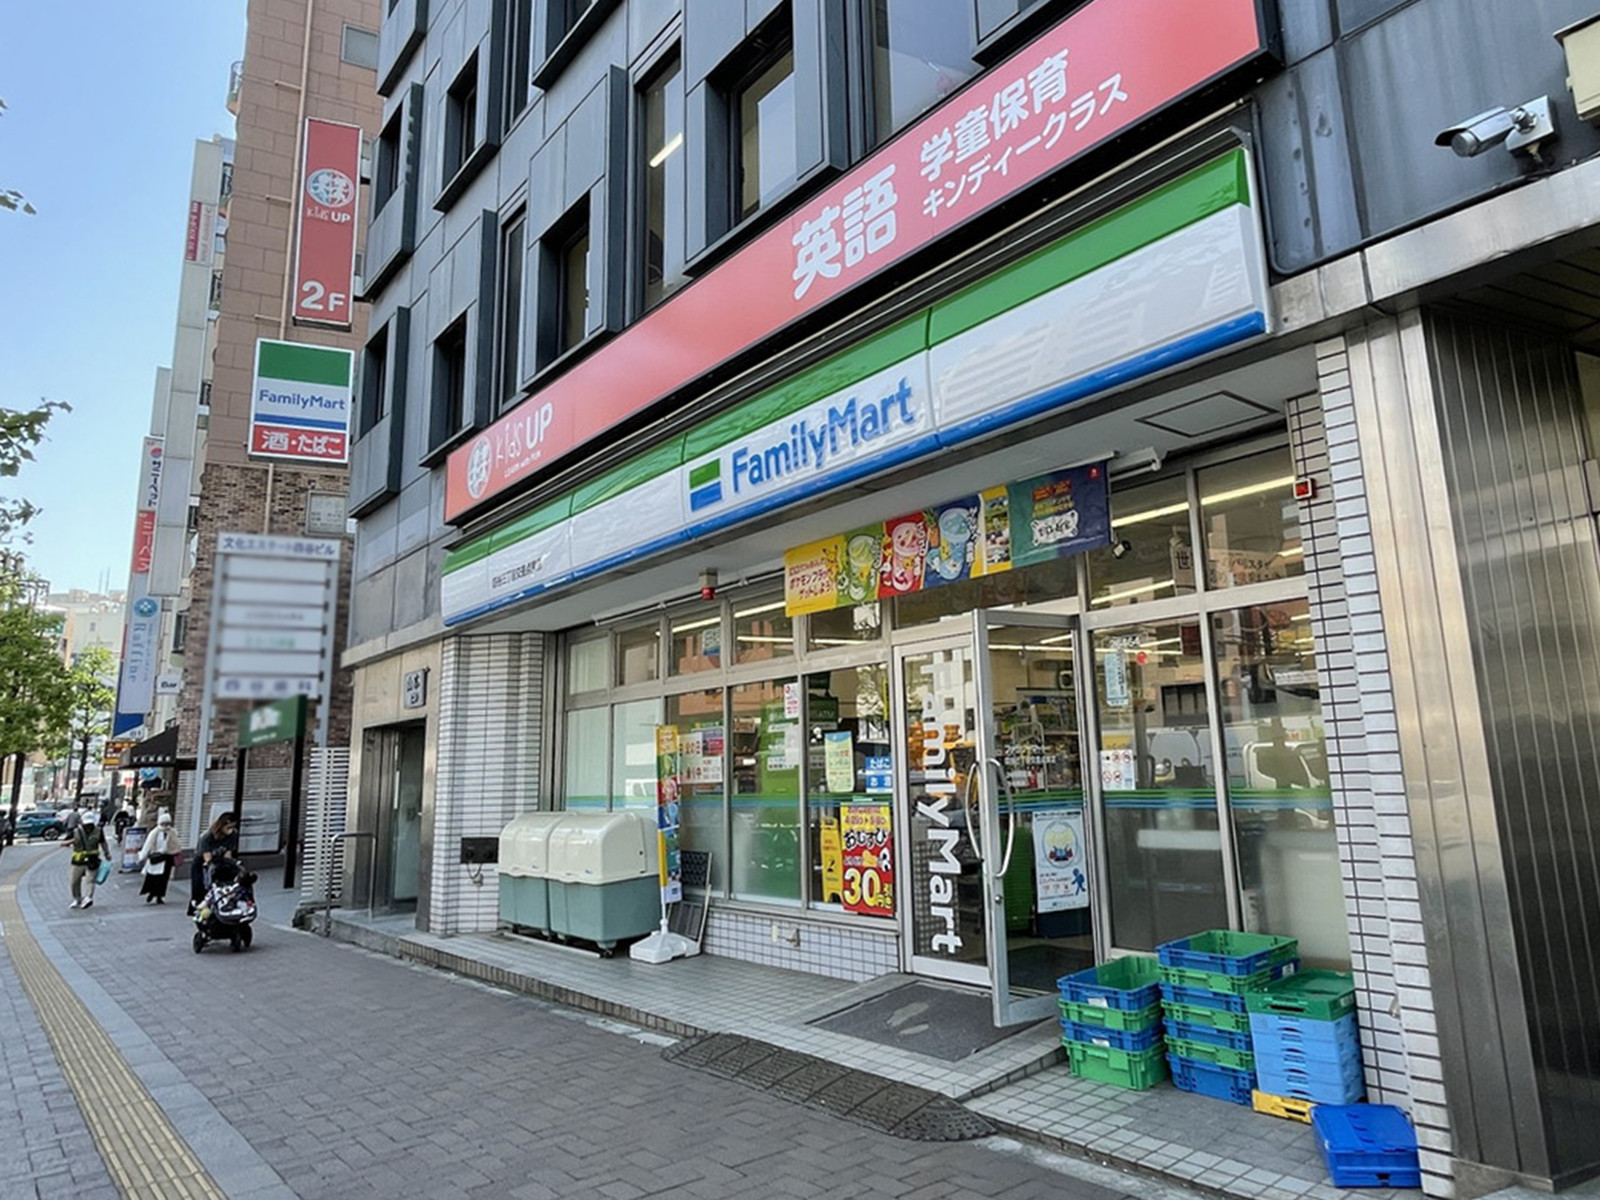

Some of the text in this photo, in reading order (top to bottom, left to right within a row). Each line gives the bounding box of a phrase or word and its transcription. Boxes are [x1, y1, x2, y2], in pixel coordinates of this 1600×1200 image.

[920, 48, 1069, 182] 学童保育
[922, 73, 1130, 218] キンディークラス
[330, 211, 351, 223] UP
[792, 163, 899, 301] 英語
[300, 280, 346, 312] 2F
[259, 389, 346, 410] FamilyMart
[261, 430, 341, 455] 酒・たばこ
[525, 402, 553, 450] UP
[731, 376, 915, 495] FamilyMart
[843, 867, 881, 908] 30
